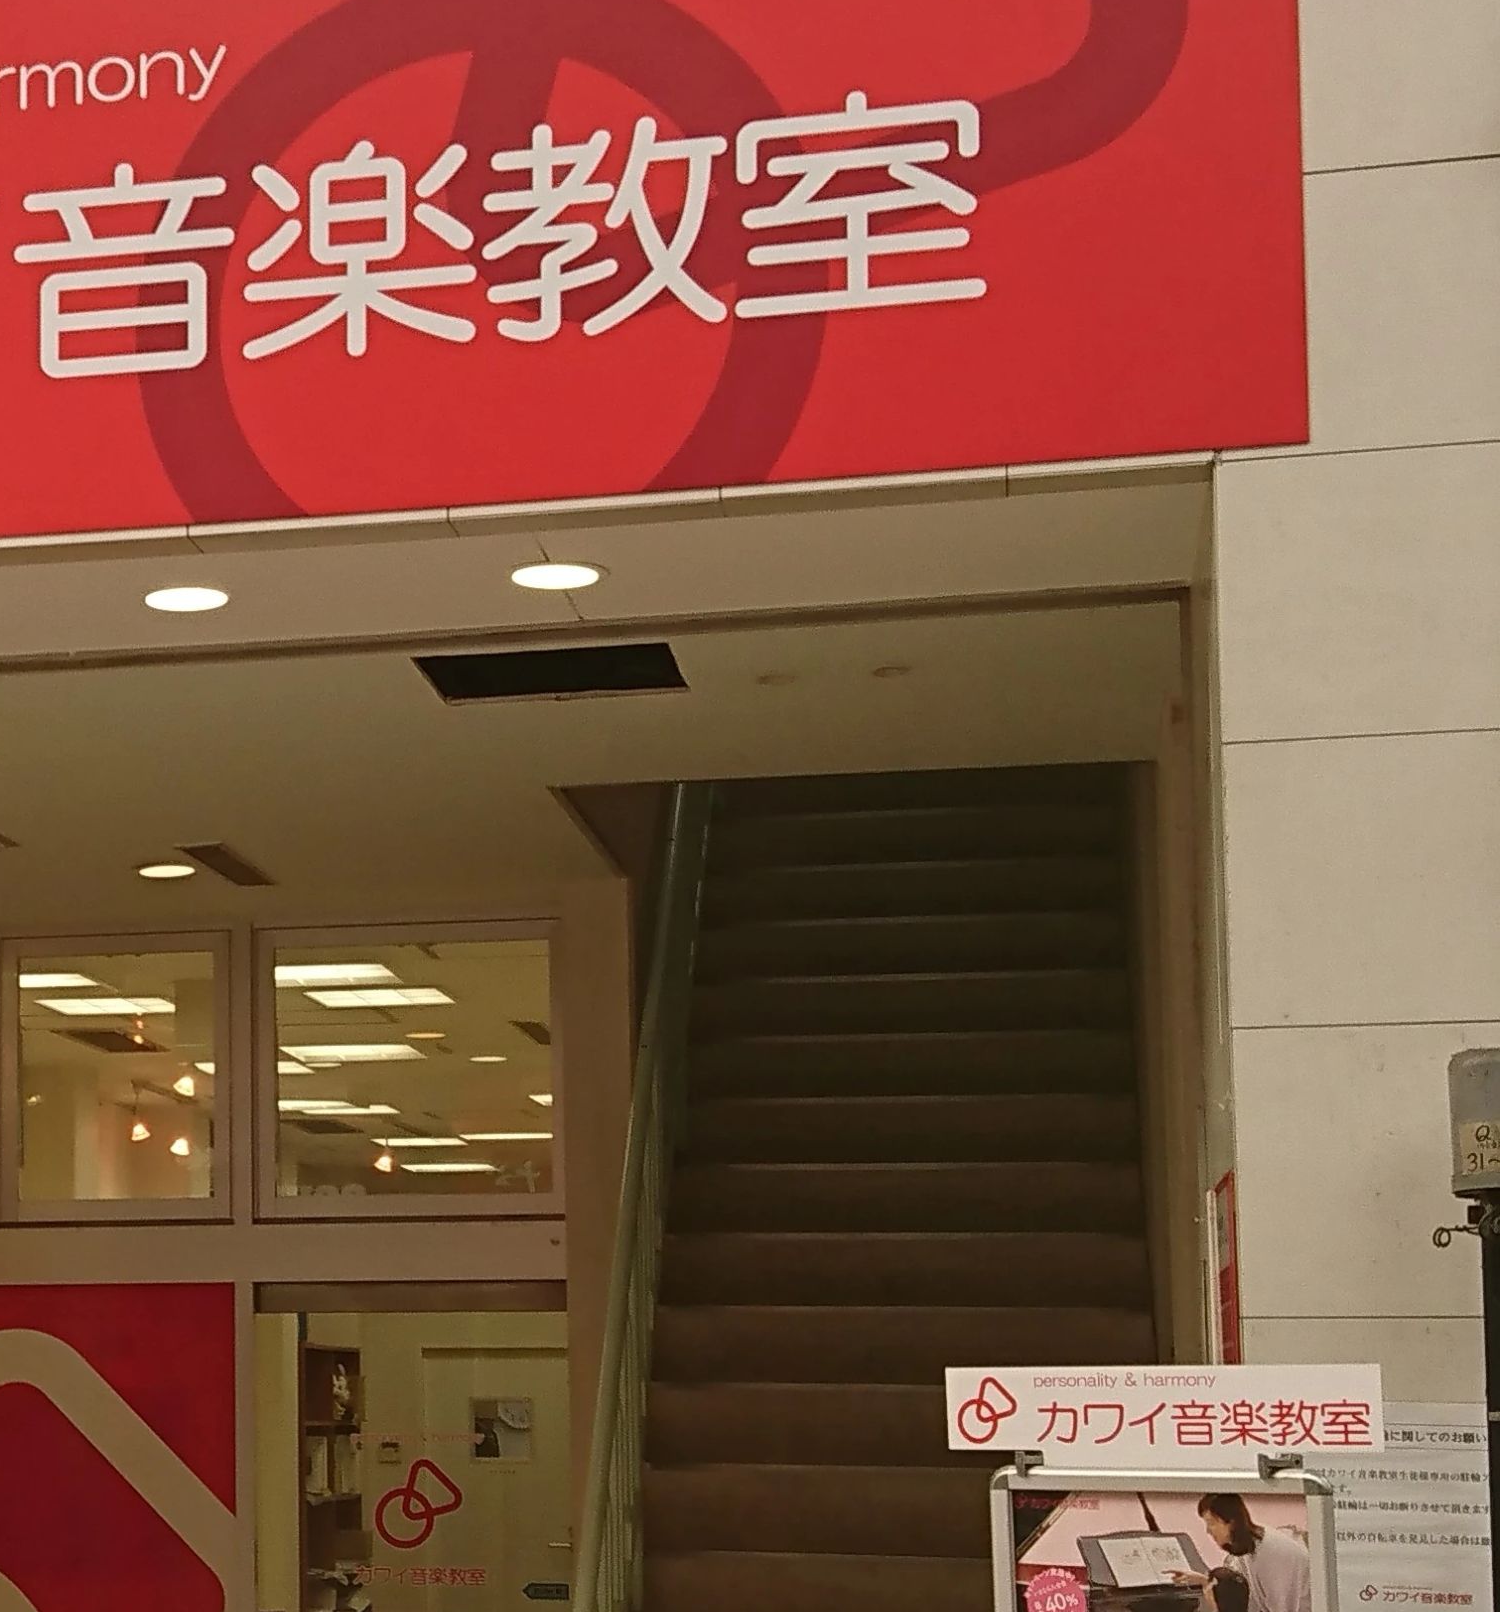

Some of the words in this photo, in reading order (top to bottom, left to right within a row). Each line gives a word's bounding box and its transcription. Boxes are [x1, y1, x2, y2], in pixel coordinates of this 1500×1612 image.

[1033, 1372, 1117, 1388] personality
[1124, 1372, 1139, 1387] &
[1143, 1372, 1217, 1388] harmony
[1037, 1399, 1373, 1446] カワイ音楽教室
[355, 1564, 487, 1586] カワイ音楽教室
[1046, 1592, 1079, 1612] 40%
[1383, 1590, 1474, 1605] カワイ音楽教室
